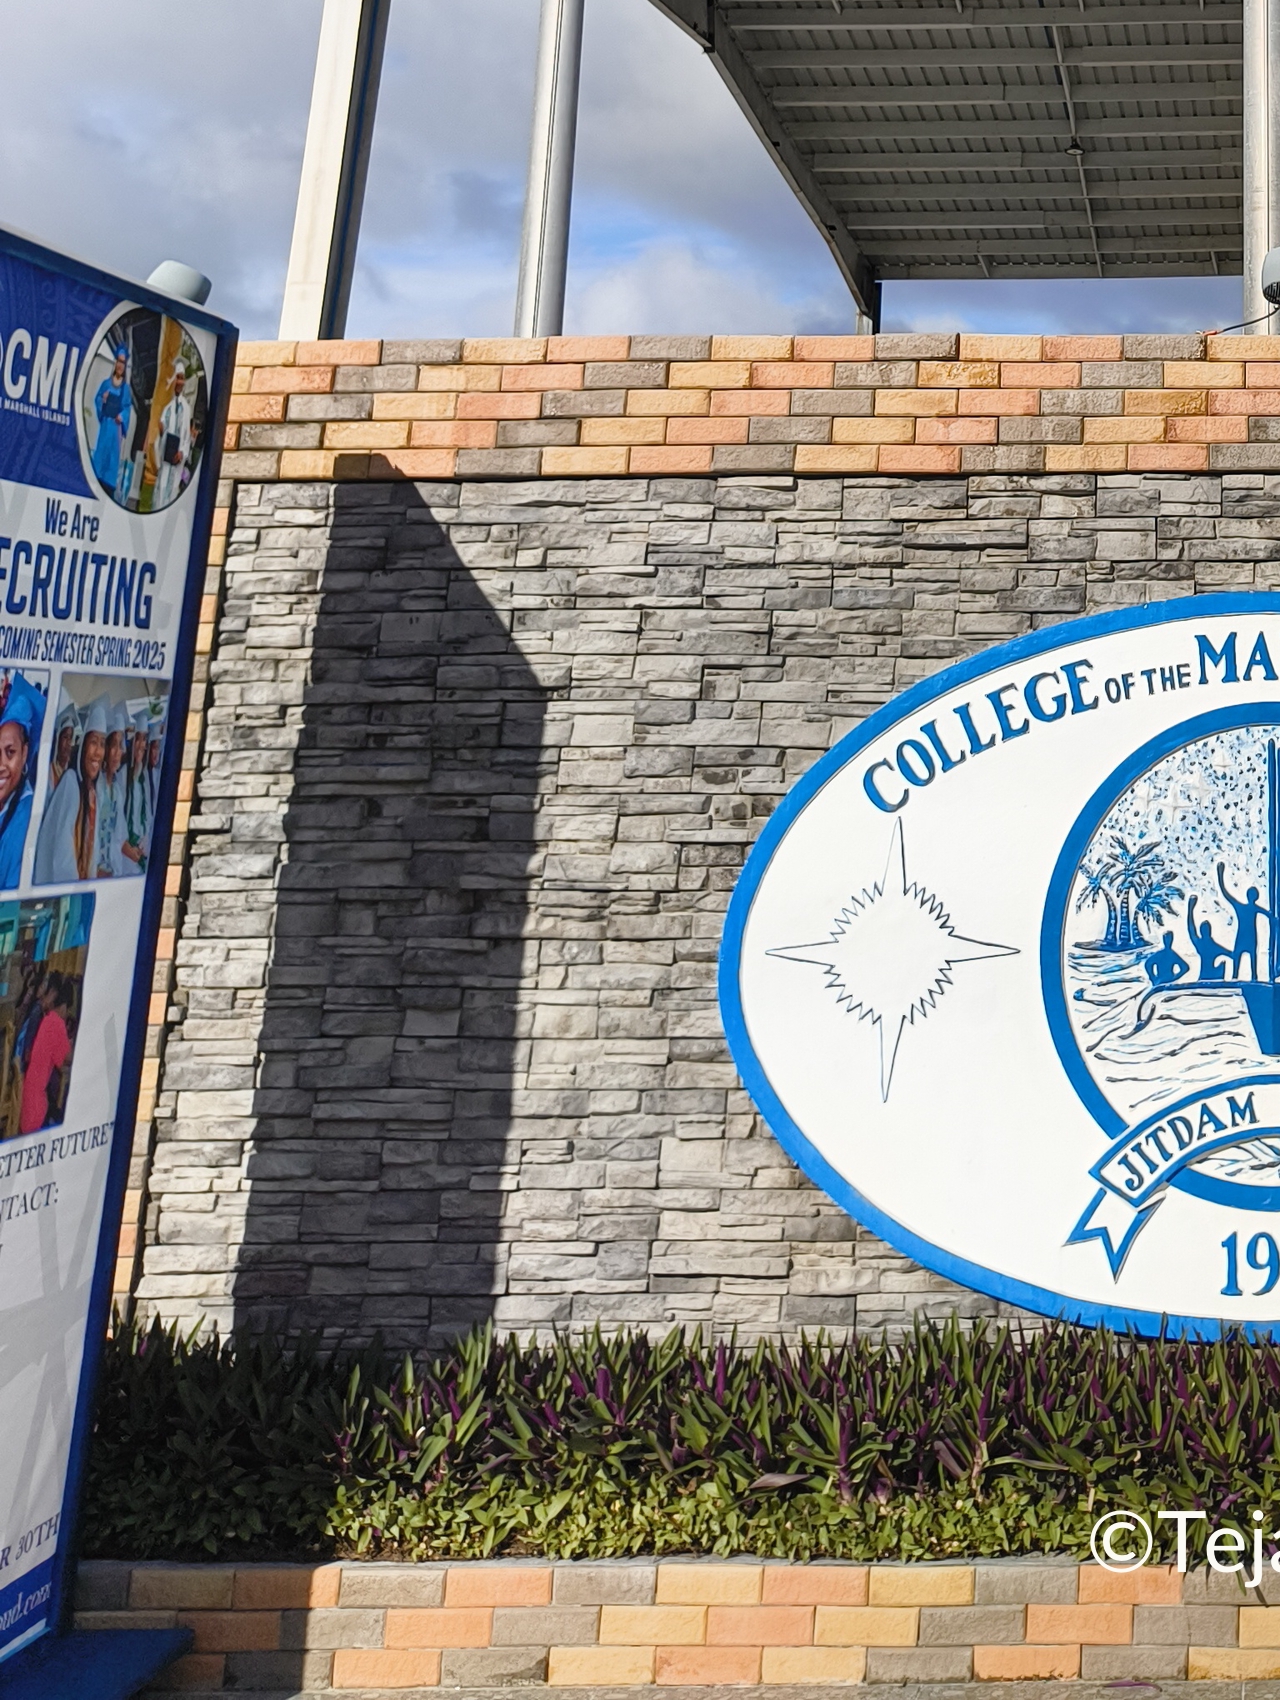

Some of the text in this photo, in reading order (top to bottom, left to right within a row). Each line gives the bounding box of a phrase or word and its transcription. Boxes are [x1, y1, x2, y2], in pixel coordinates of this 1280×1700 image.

[4, 328, 80, 413] CMI
[4, 398, 40, 419] MARSHALL
[41, 409, 70, 427] ISLANDS
[45, 497, 100, 542] We Are
[41, 630, 96, 667] SEMESTER
[95, 635, 132, 668] SPRING
[132, 640, 166, 671] 2025
[863, 658, 1100, 813] COLLEGE
[1105, 672, 1136, 703] OF
[1140, 663, 1192, 696] THE
[1117, 1091, 1260, 1191] JITDAM
[15, 1512, 60, 1560] 30TH
